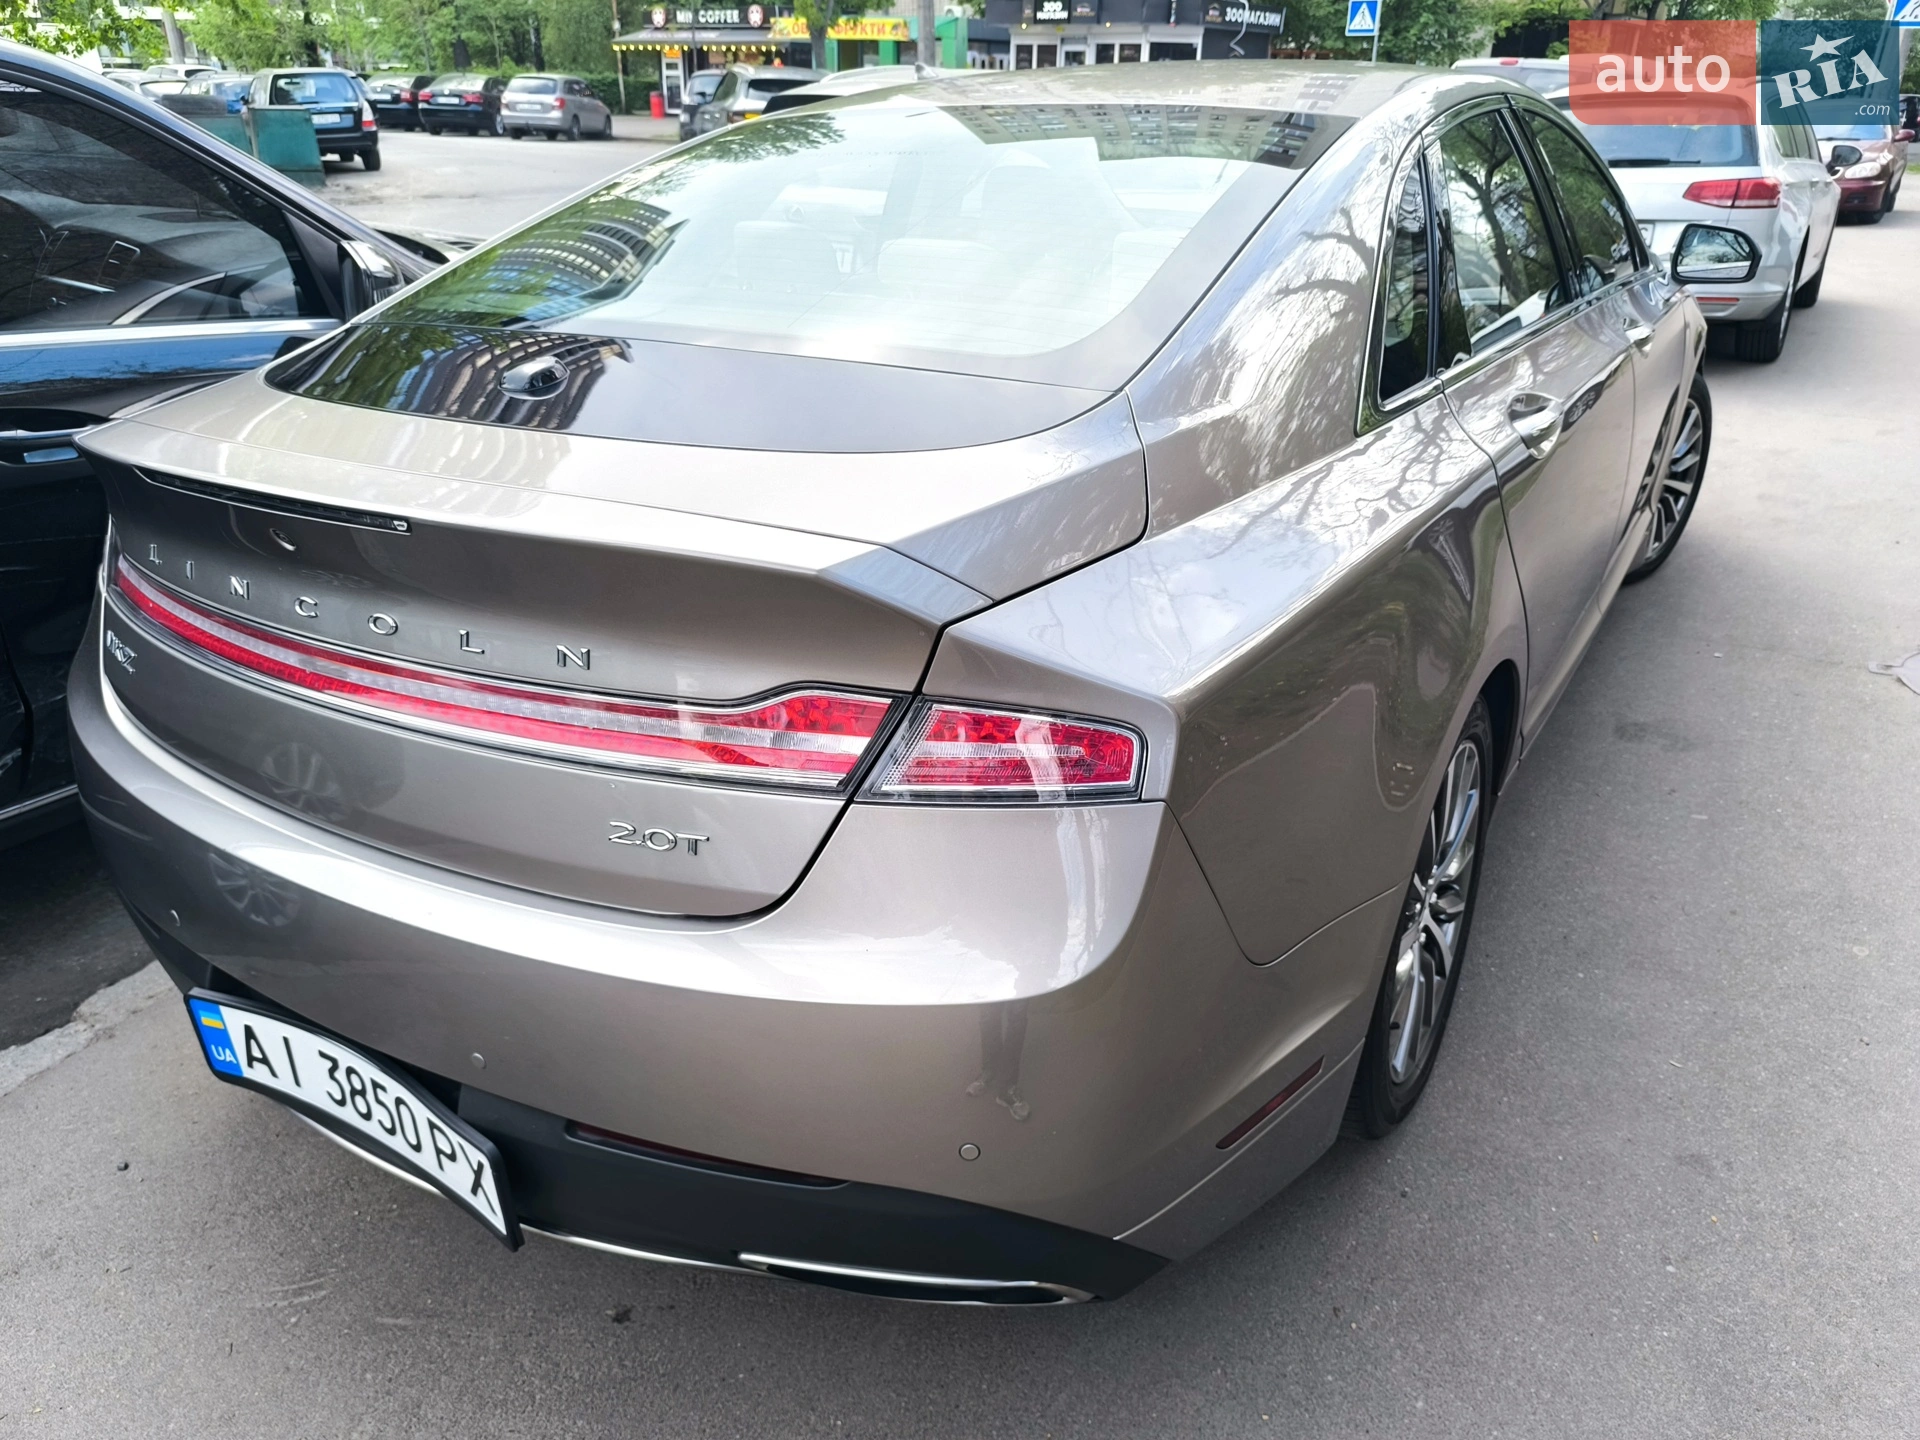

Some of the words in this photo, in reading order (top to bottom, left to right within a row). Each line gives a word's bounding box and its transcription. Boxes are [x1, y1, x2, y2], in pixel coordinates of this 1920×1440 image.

[698, 9, 740, 23] COFFEE
[148, 543, 592, 672] LINCOLN
[211, 1045, 237, 1064] UA
